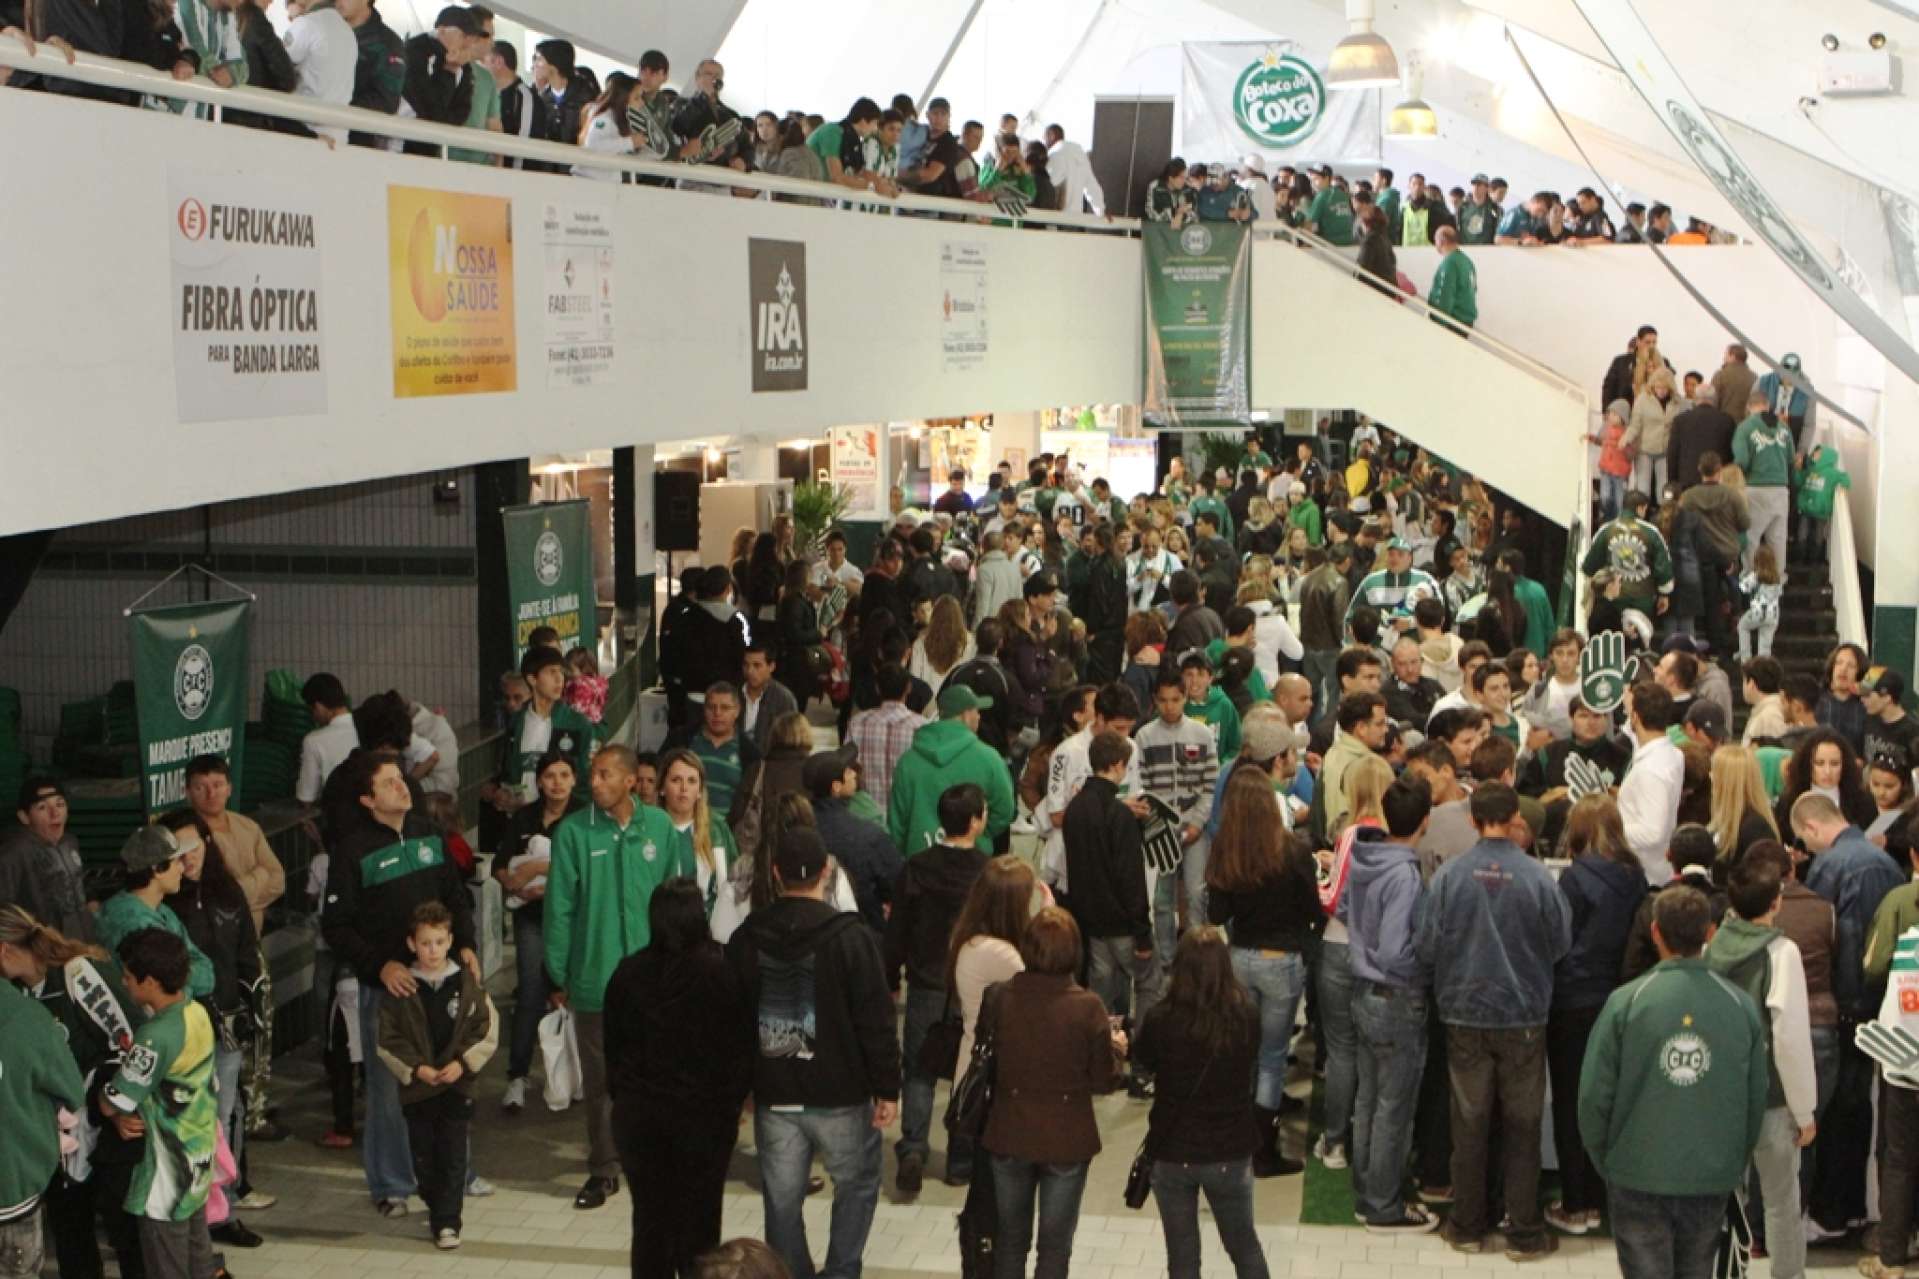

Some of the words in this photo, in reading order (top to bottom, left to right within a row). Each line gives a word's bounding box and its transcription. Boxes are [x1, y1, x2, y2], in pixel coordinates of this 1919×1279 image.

[209, 203, 315, 249] FURUKAWA
[182, 284, 244, 331] FIBRA
[249, 272, 319, 332] ÓPTICA
[758, 302, 802, 350] IRA
[208, 344, 230, 362] PARA
[233, 343, 277, 373] BANDA
[279, 343, 320, 372] LARGA
[149, 735, 188, 765] MARQUE
